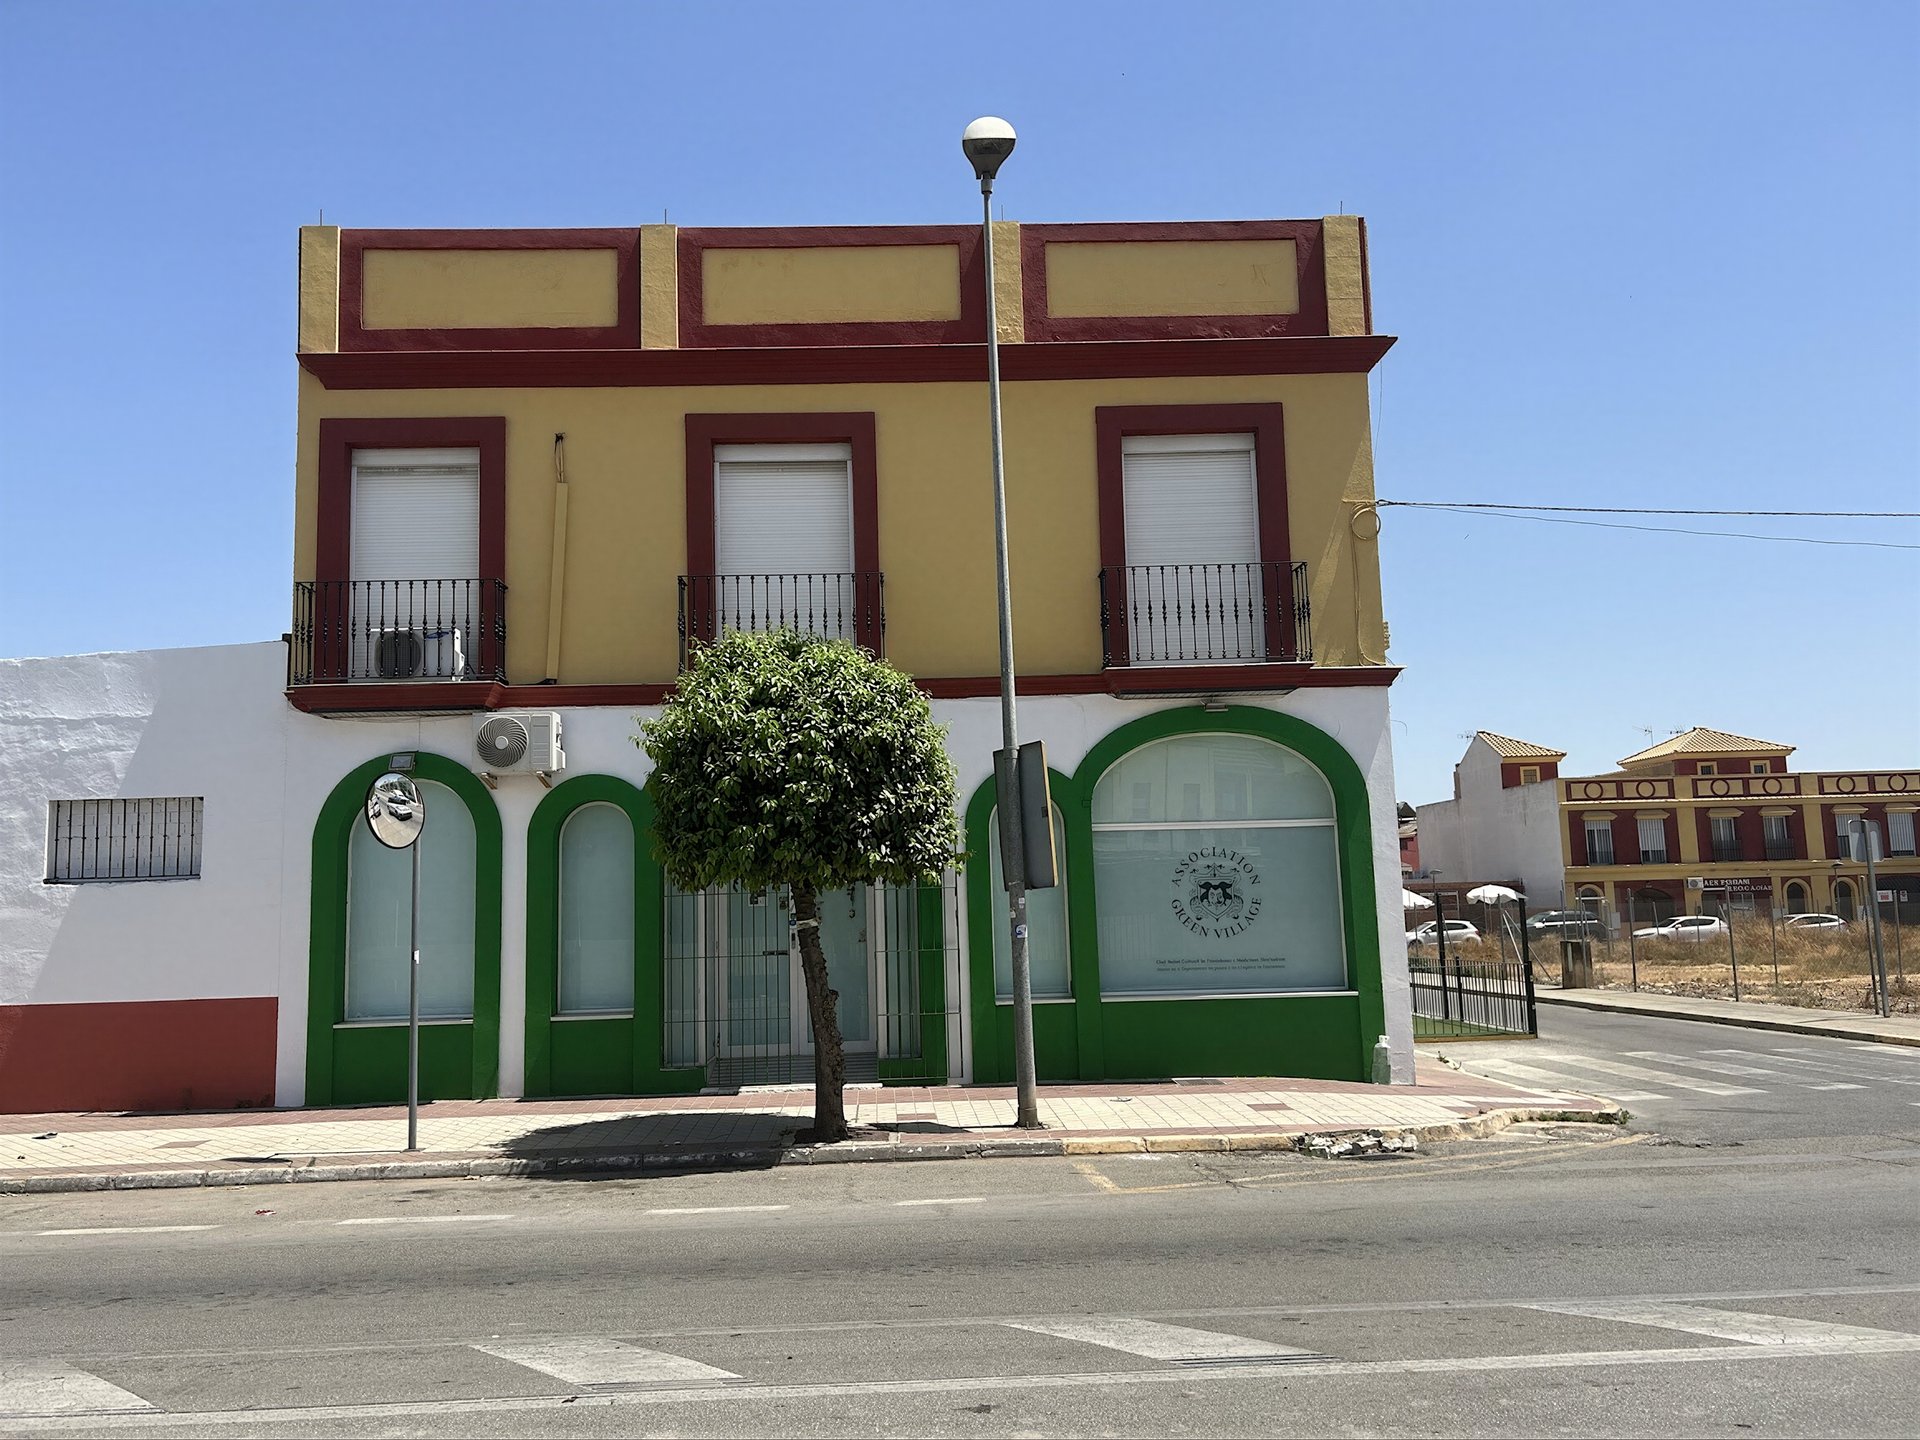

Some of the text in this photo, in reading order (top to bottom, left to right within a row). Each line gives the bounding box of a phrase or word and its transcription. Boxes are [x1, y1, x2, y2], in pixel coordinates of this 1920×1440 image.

[1171, 846, 1261, 888] ASSOCIATION
[1171, 897, 1262, 939] GREEN VILLAGE
